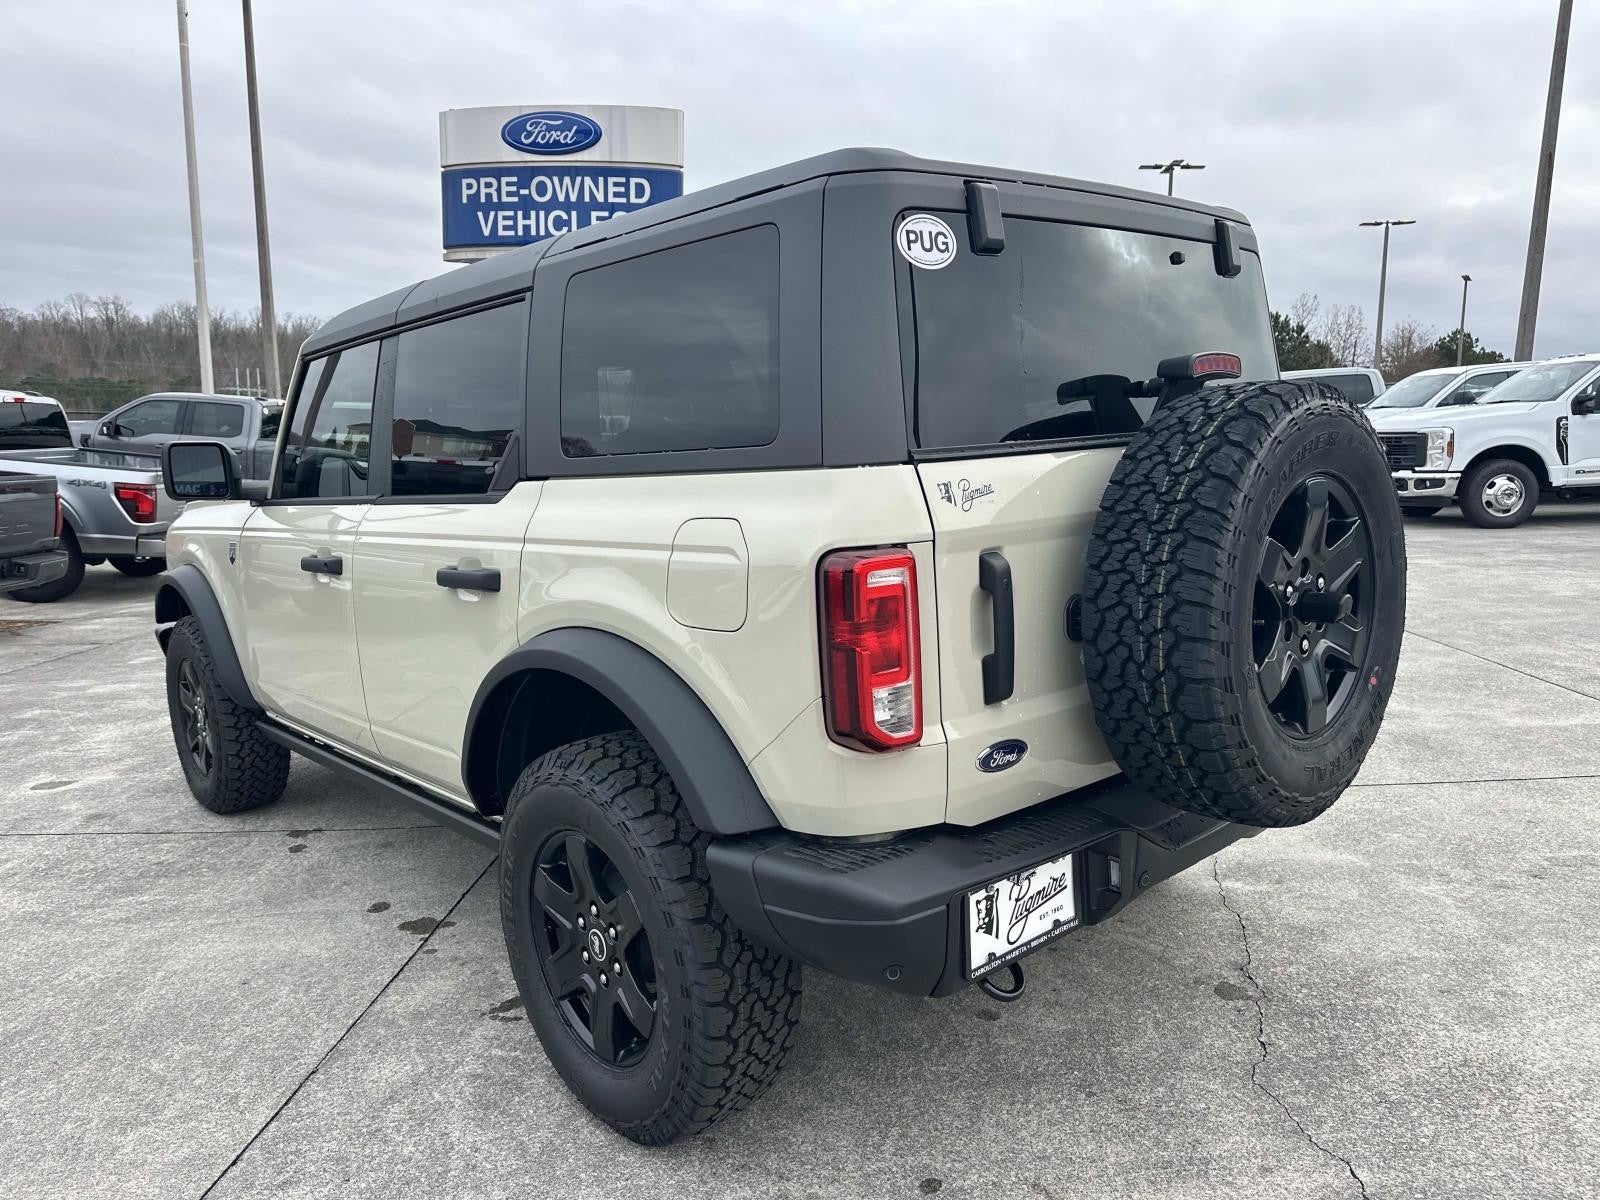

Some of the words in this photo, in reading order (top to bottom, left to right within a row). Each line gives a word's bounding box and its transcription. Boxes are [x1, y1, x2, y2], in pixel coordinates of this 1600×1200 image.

[520, 119, 578, 145] Ford
[461, 175, 652, 204] PRE-OWNED
[905, 229, 950, 254] PUG
[957, 478, 995, 513] Pugmire
[990, 749, 1018, 768] Ford
[1006, 871, 1068, 946] Pugmire
